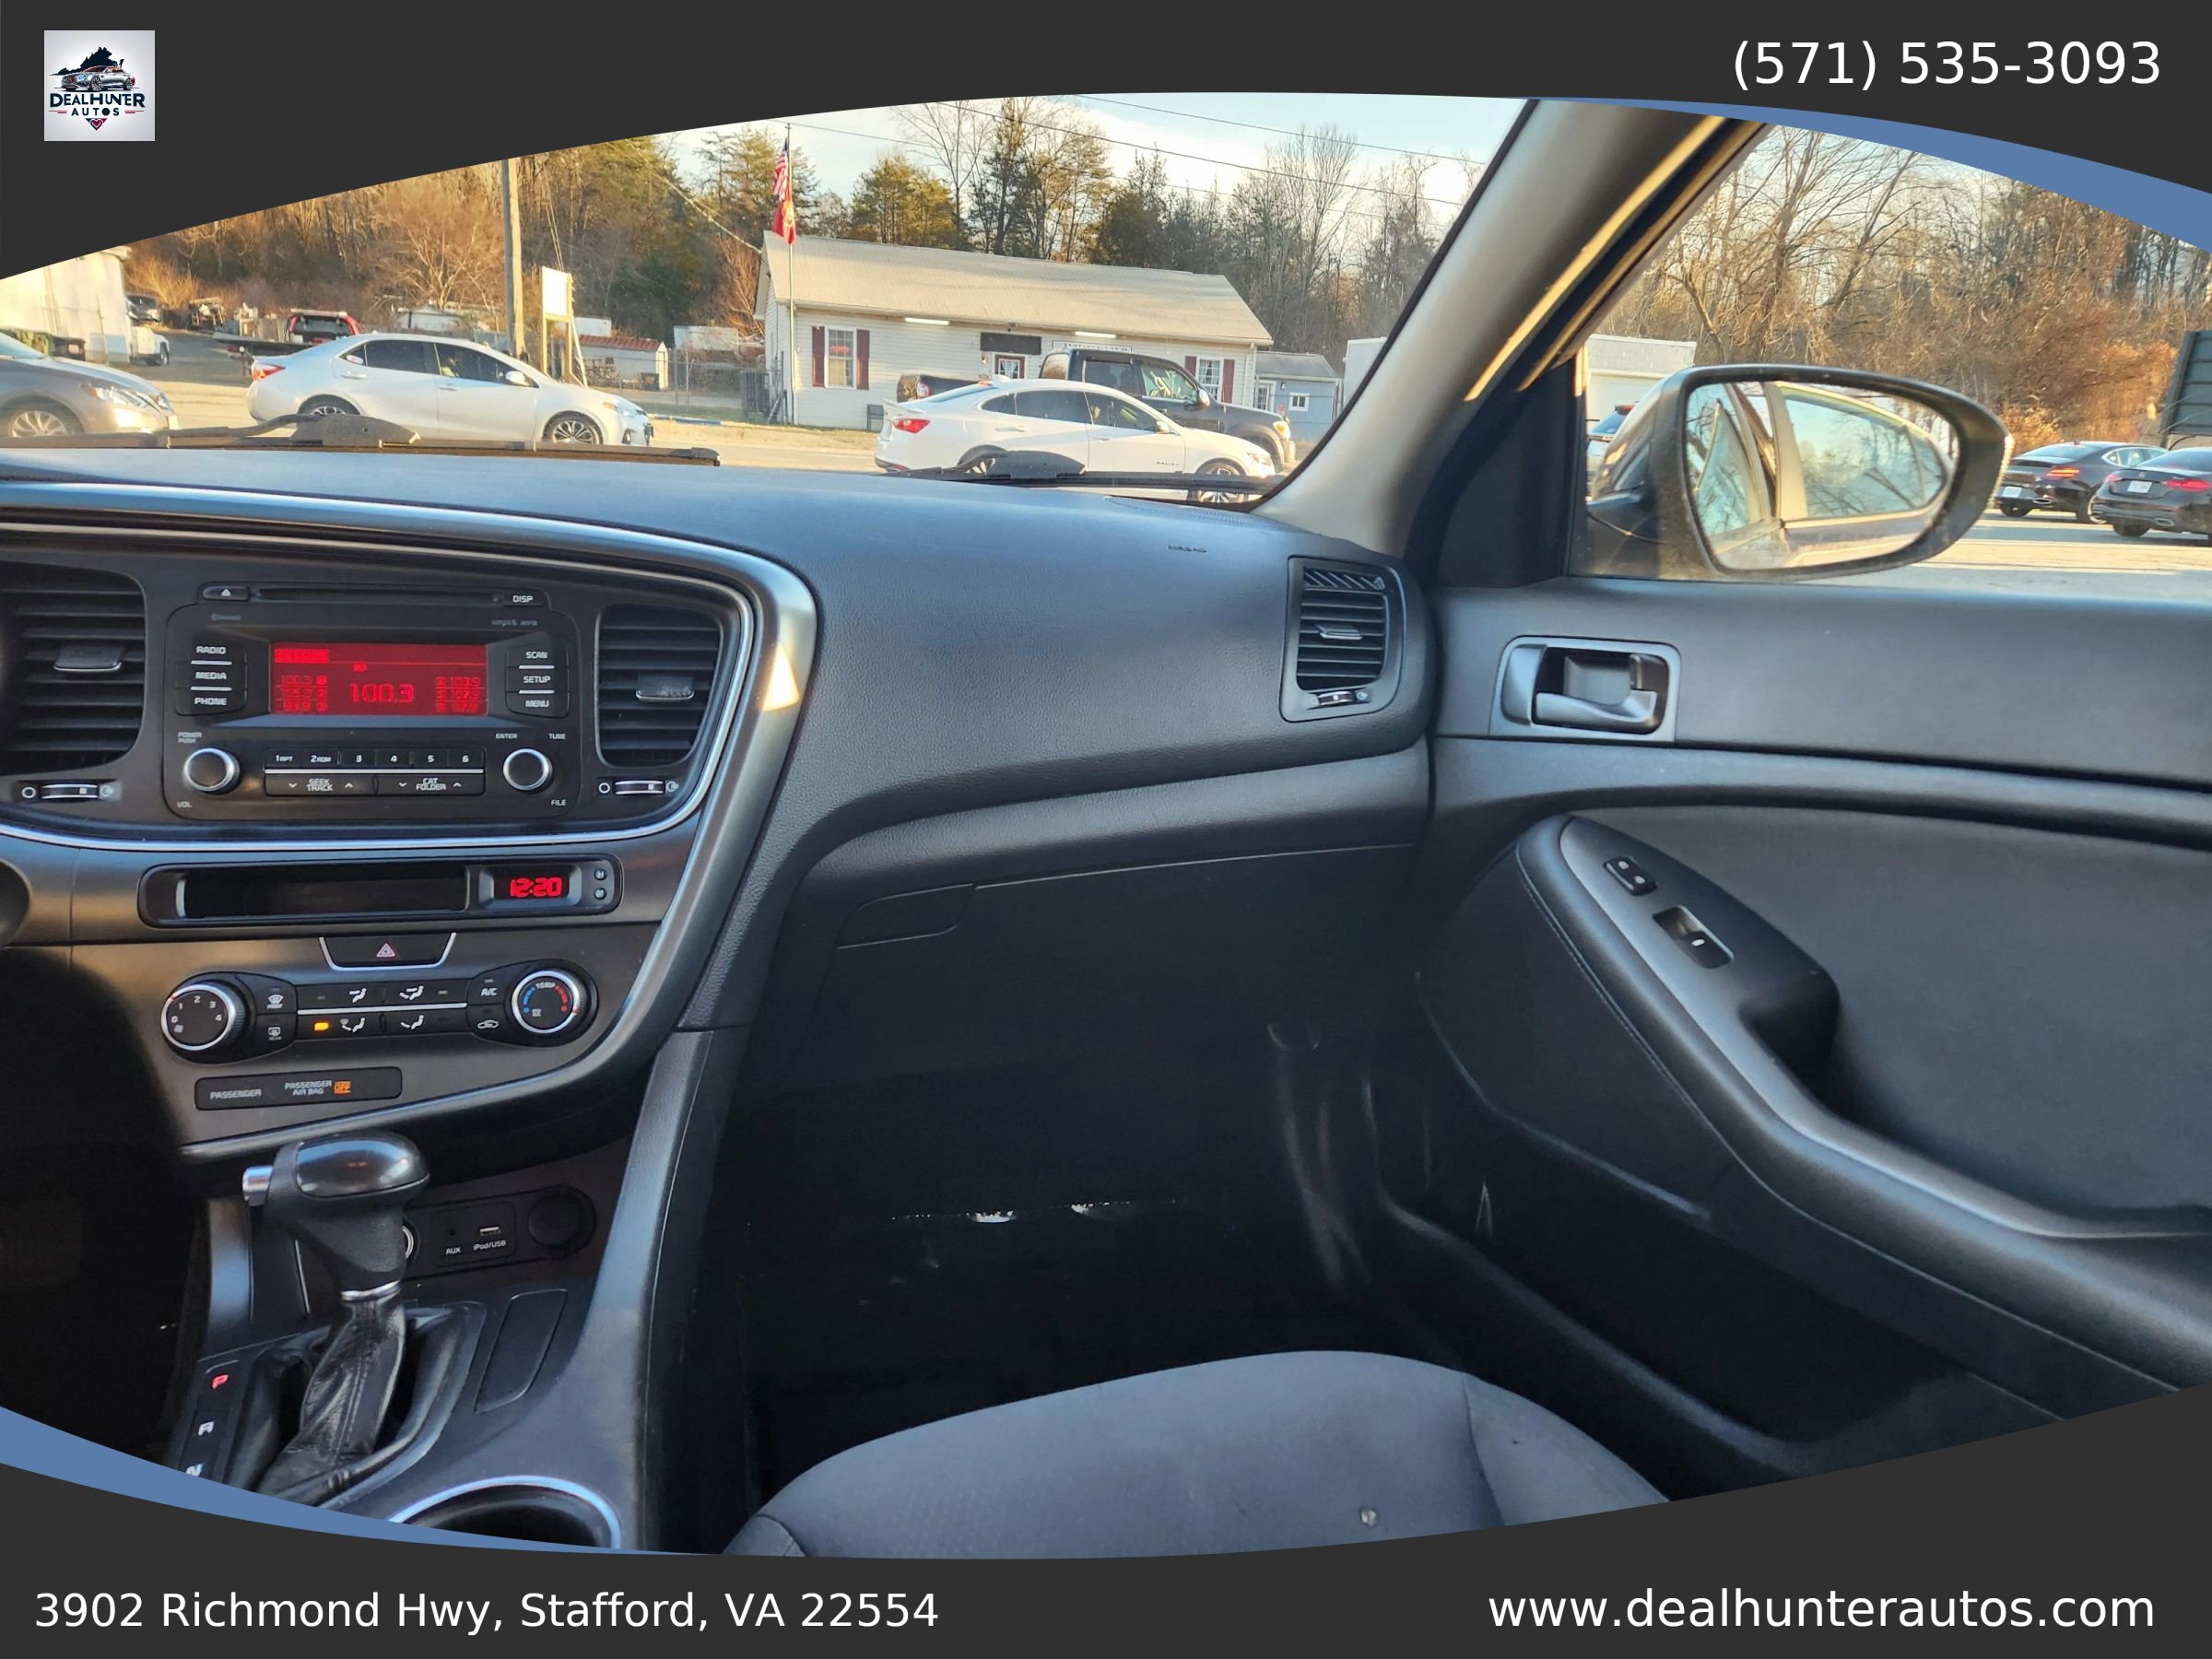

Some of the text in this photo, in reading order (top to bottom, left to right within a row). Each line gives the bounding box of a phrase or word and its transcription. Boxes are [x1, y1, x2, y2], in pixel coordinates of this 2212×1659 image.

[512, 594, 534, 603] DISP
[196, 646, 227, 654] RADIO
[525, 651, 547, 659] SCAN
[195, 672, 227, 680] MEDIA
[524, 676, 551, 684] SETUP
[350, 682, 414, 703] 100.3
[194, 697, 228, 706] PHONE
[525, 700, 549, 708] MENU
[356, 755, 362, 763] 3
[390, 755, 398, 763] 4
[428, 755, 435, 763] 5
[462, 755, 469, 763] 6
[306, 783, 334, 792] TRACK
[510, 877, 562, 898] 12:20
[480, 988, 498, 996] A/C
[194, 995, 201, 1004] 2
[209, 1001, 217, 1009] 3
[215, 1014, 222, 1022] 4
[285, 1079, 332, 1090] PASSENGER
[210, 1088, 262, 1100] PASSENGER
[473, 1239, 507, 1252] iPod/USB
[446, 1246, 462, 1255] AUX
[211, 1373, 229, 1390] P
[197, 1420, 215, 1437] R
